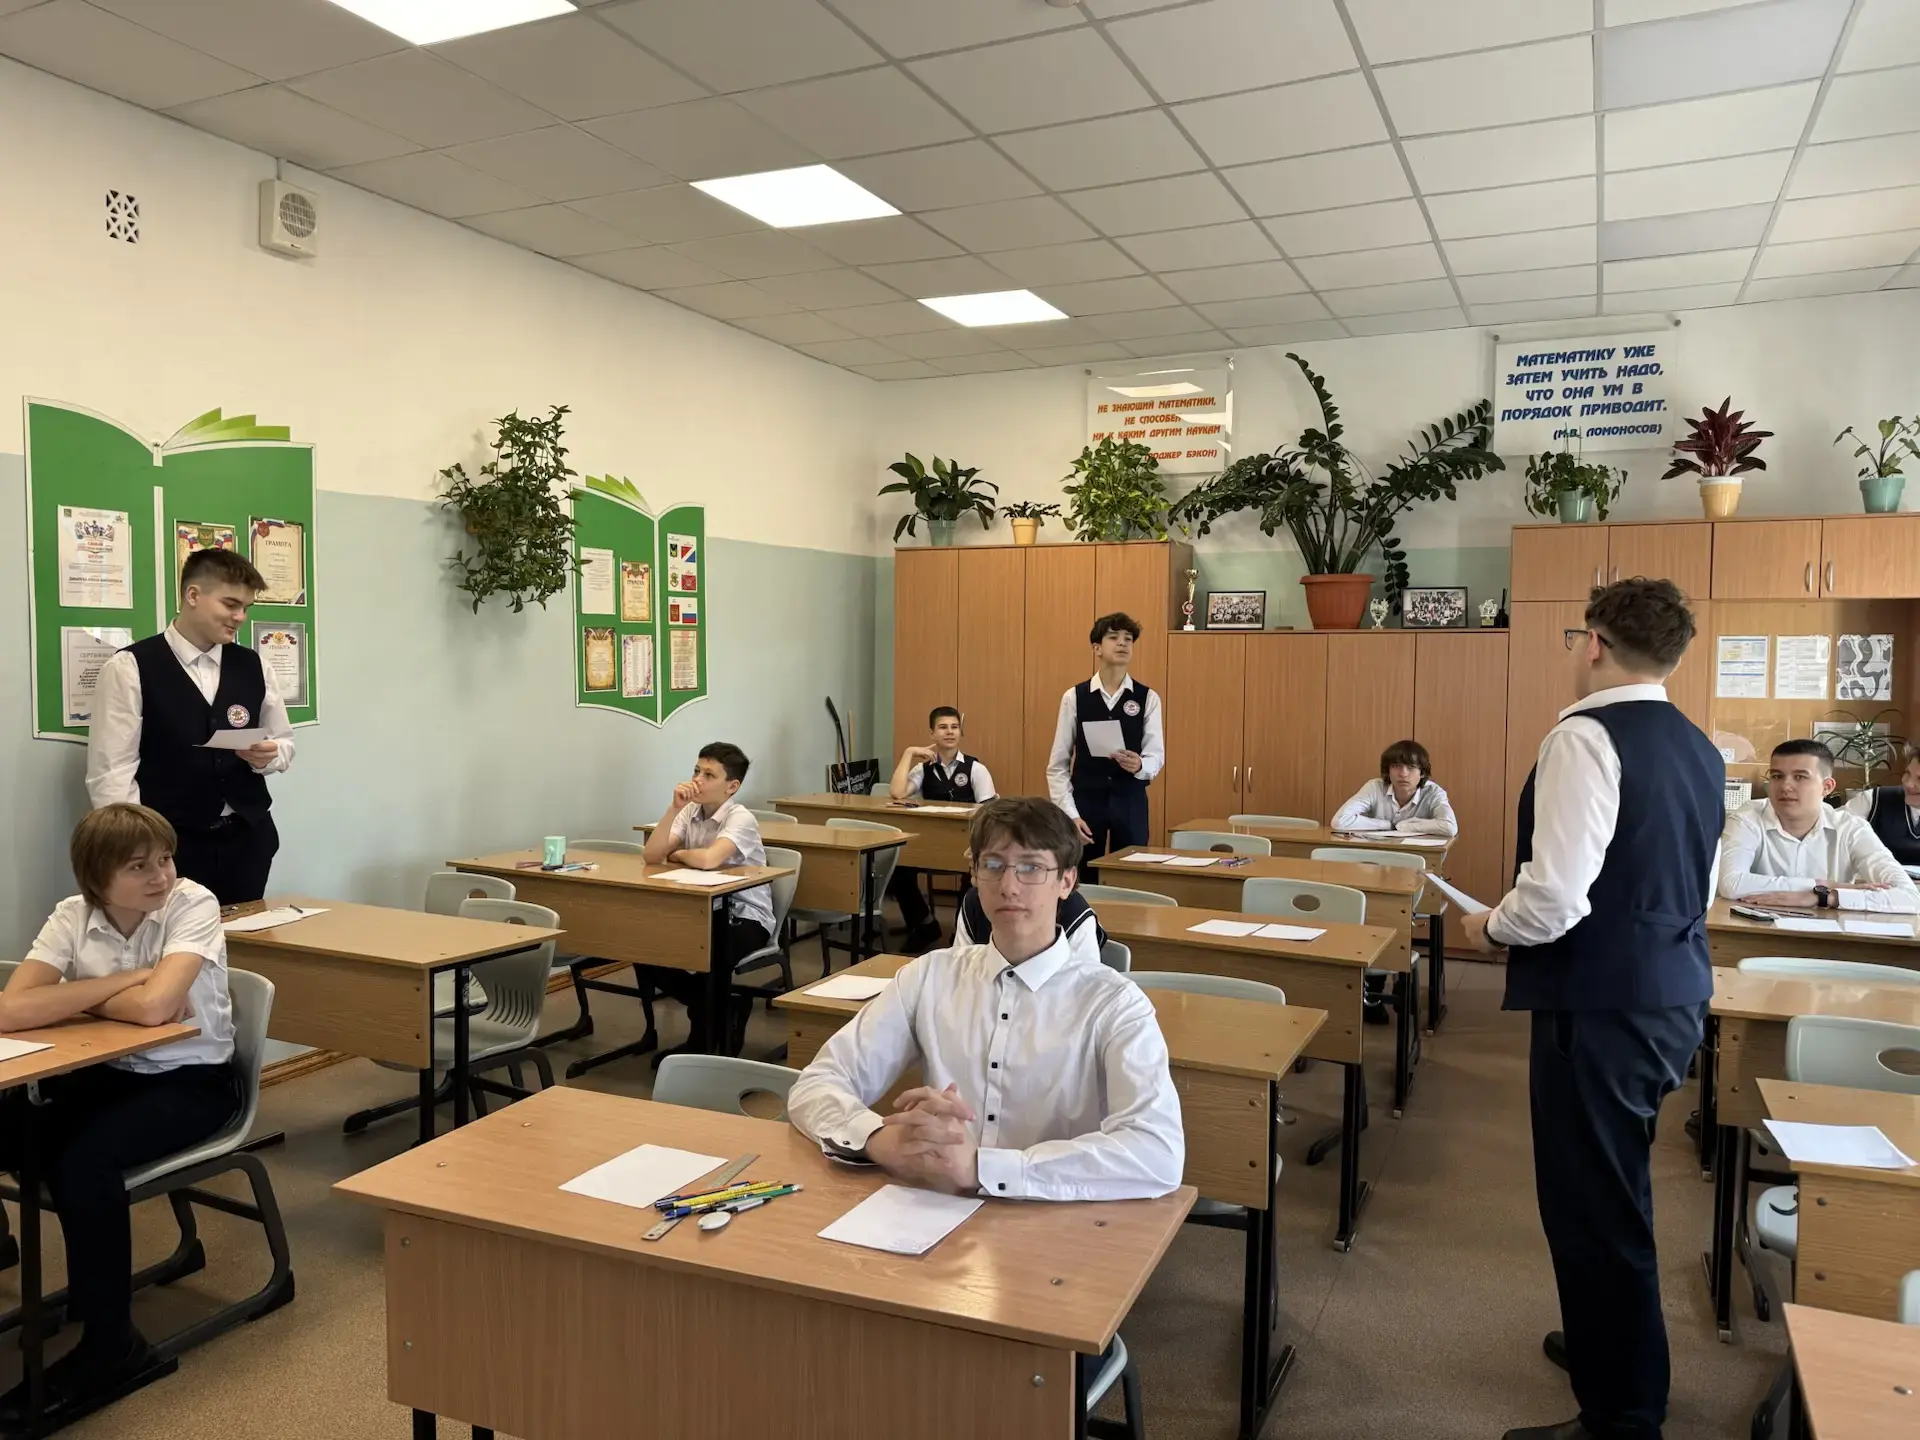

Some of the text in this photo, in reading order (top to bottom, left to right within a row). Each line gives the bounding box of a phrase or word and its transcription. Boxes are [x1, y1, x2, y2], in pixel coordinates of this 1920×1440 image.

[1516, 344, 1656, 367] МАТЕМАТИКУ УЖЕ
[1506, 362, 1664, 386] ЗАТЕМ УЧИТЬ НАДО,
[1525, 382, 1643, 402] ЧТО ОНА УМ В
[1097, 404, 1108, 414] НЕ
[1501, 399, 1668, 422] ПОРЯДОК ПРИВОДИТ.
[1124, 416, 1136, 426] НЕ
[1092, 432, 1104, 442] НИ
[1117, 429, 1146, 440] КАКИМ
[1149, 427, 1182, 438] ДРУГИМ
[1186, 425, 1221, 437] НАУКАМ
[1586, 423, 1662, 438] ЛОМОНОСОВ)
[1186, 449, 1217, 459] БЭКОН)
